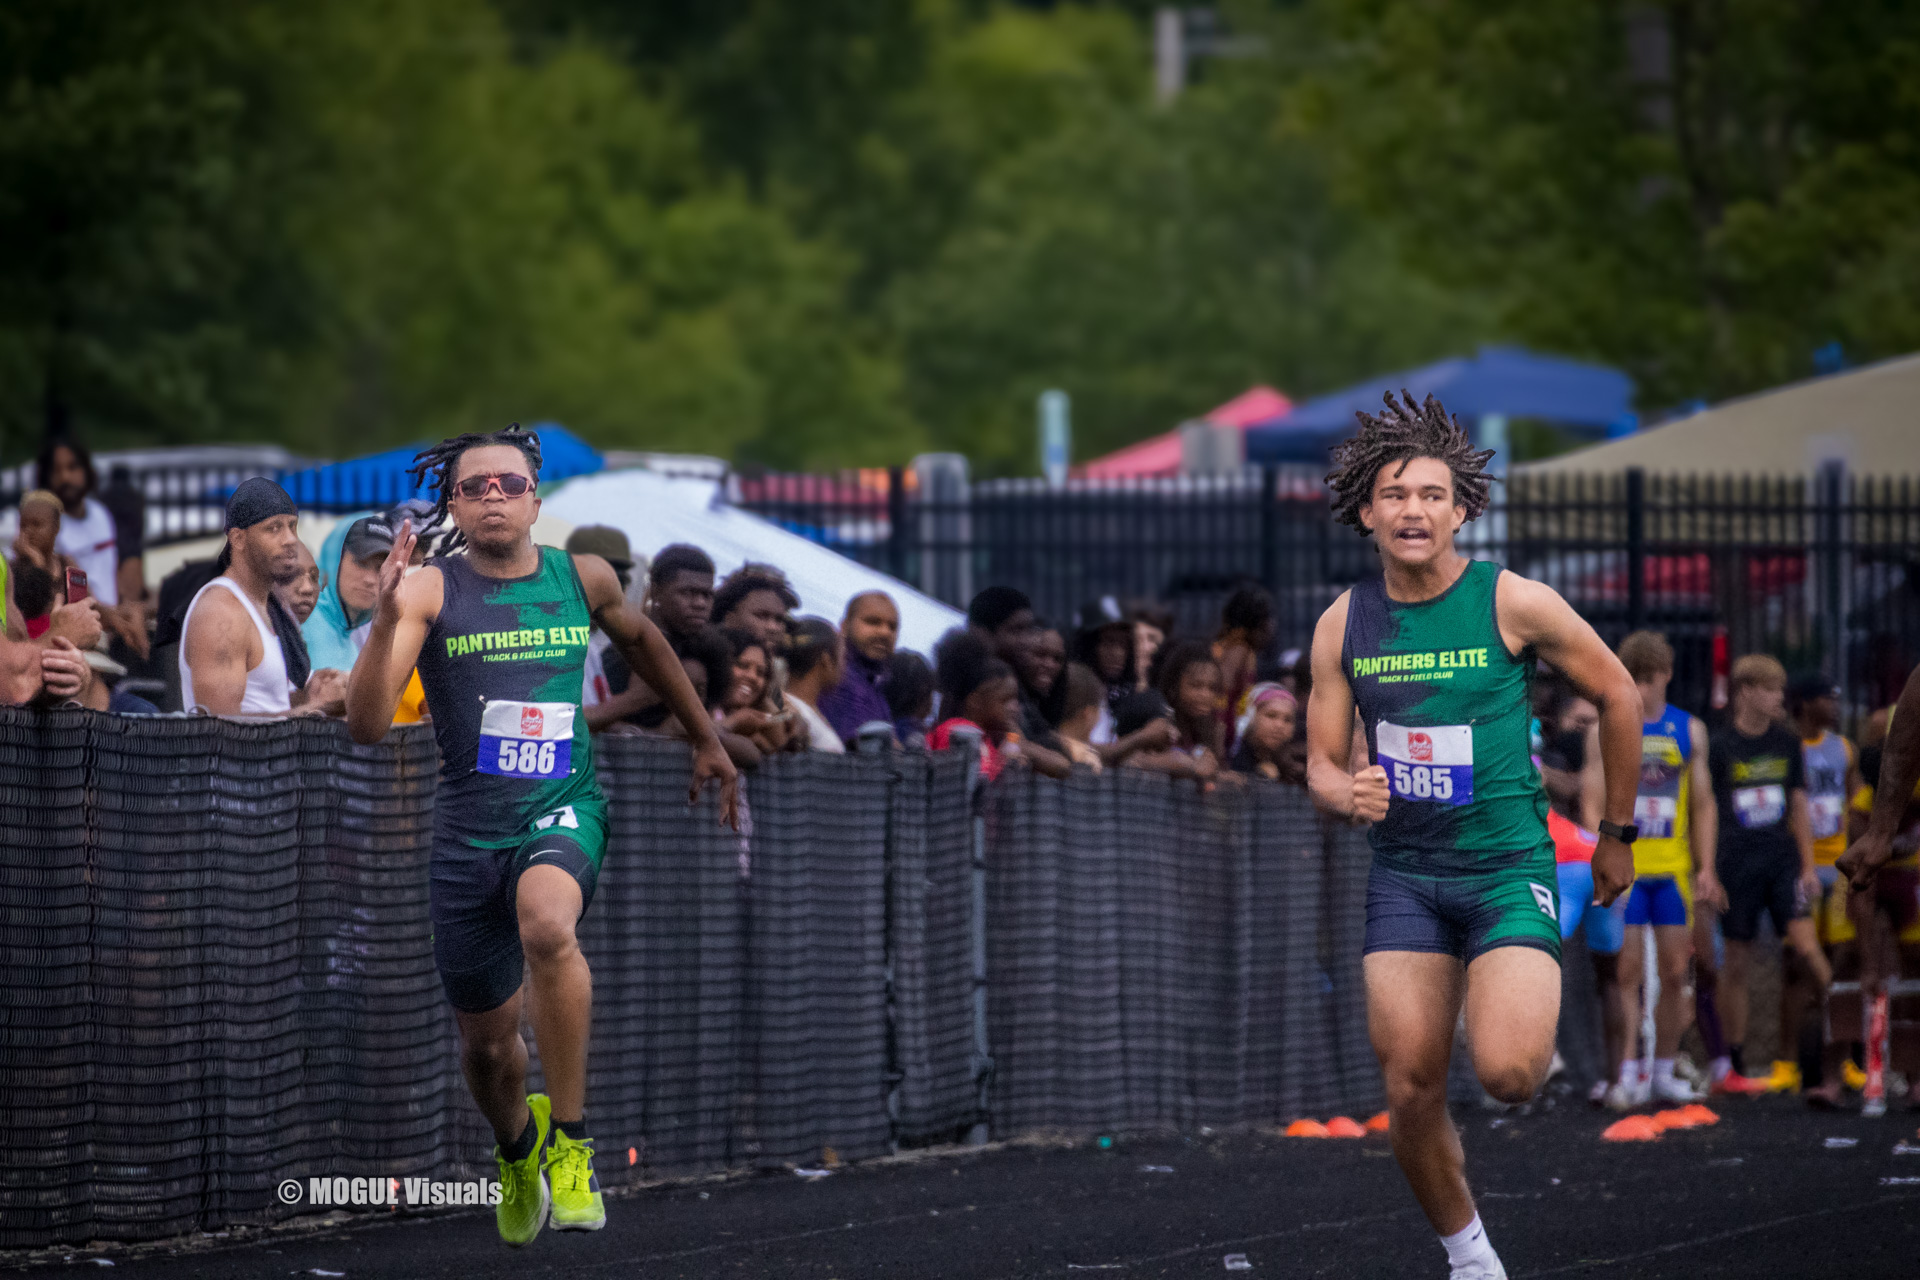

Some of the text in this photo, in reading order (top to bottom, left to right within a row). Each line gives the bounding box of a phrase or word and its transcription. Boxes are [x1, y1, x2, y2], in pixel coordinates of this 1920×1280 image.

[446, 628, 546, 658] PANTHERS
[482, 652, 510, 662] TRACK
[519, 649, 543, 659] FIELD
[544, 648, 567, 657] CLUB
[1353, 648, 1488, 678] PANTHERS ELITE
[1378, 674, 1403, 683] TRACK
[1410, 671, 1433, 681] FIELD
[1433, 670, 1454, 679] CLUB
[498, 739, 557, 774] 586
[1394, 761, 1453, 800] 585
